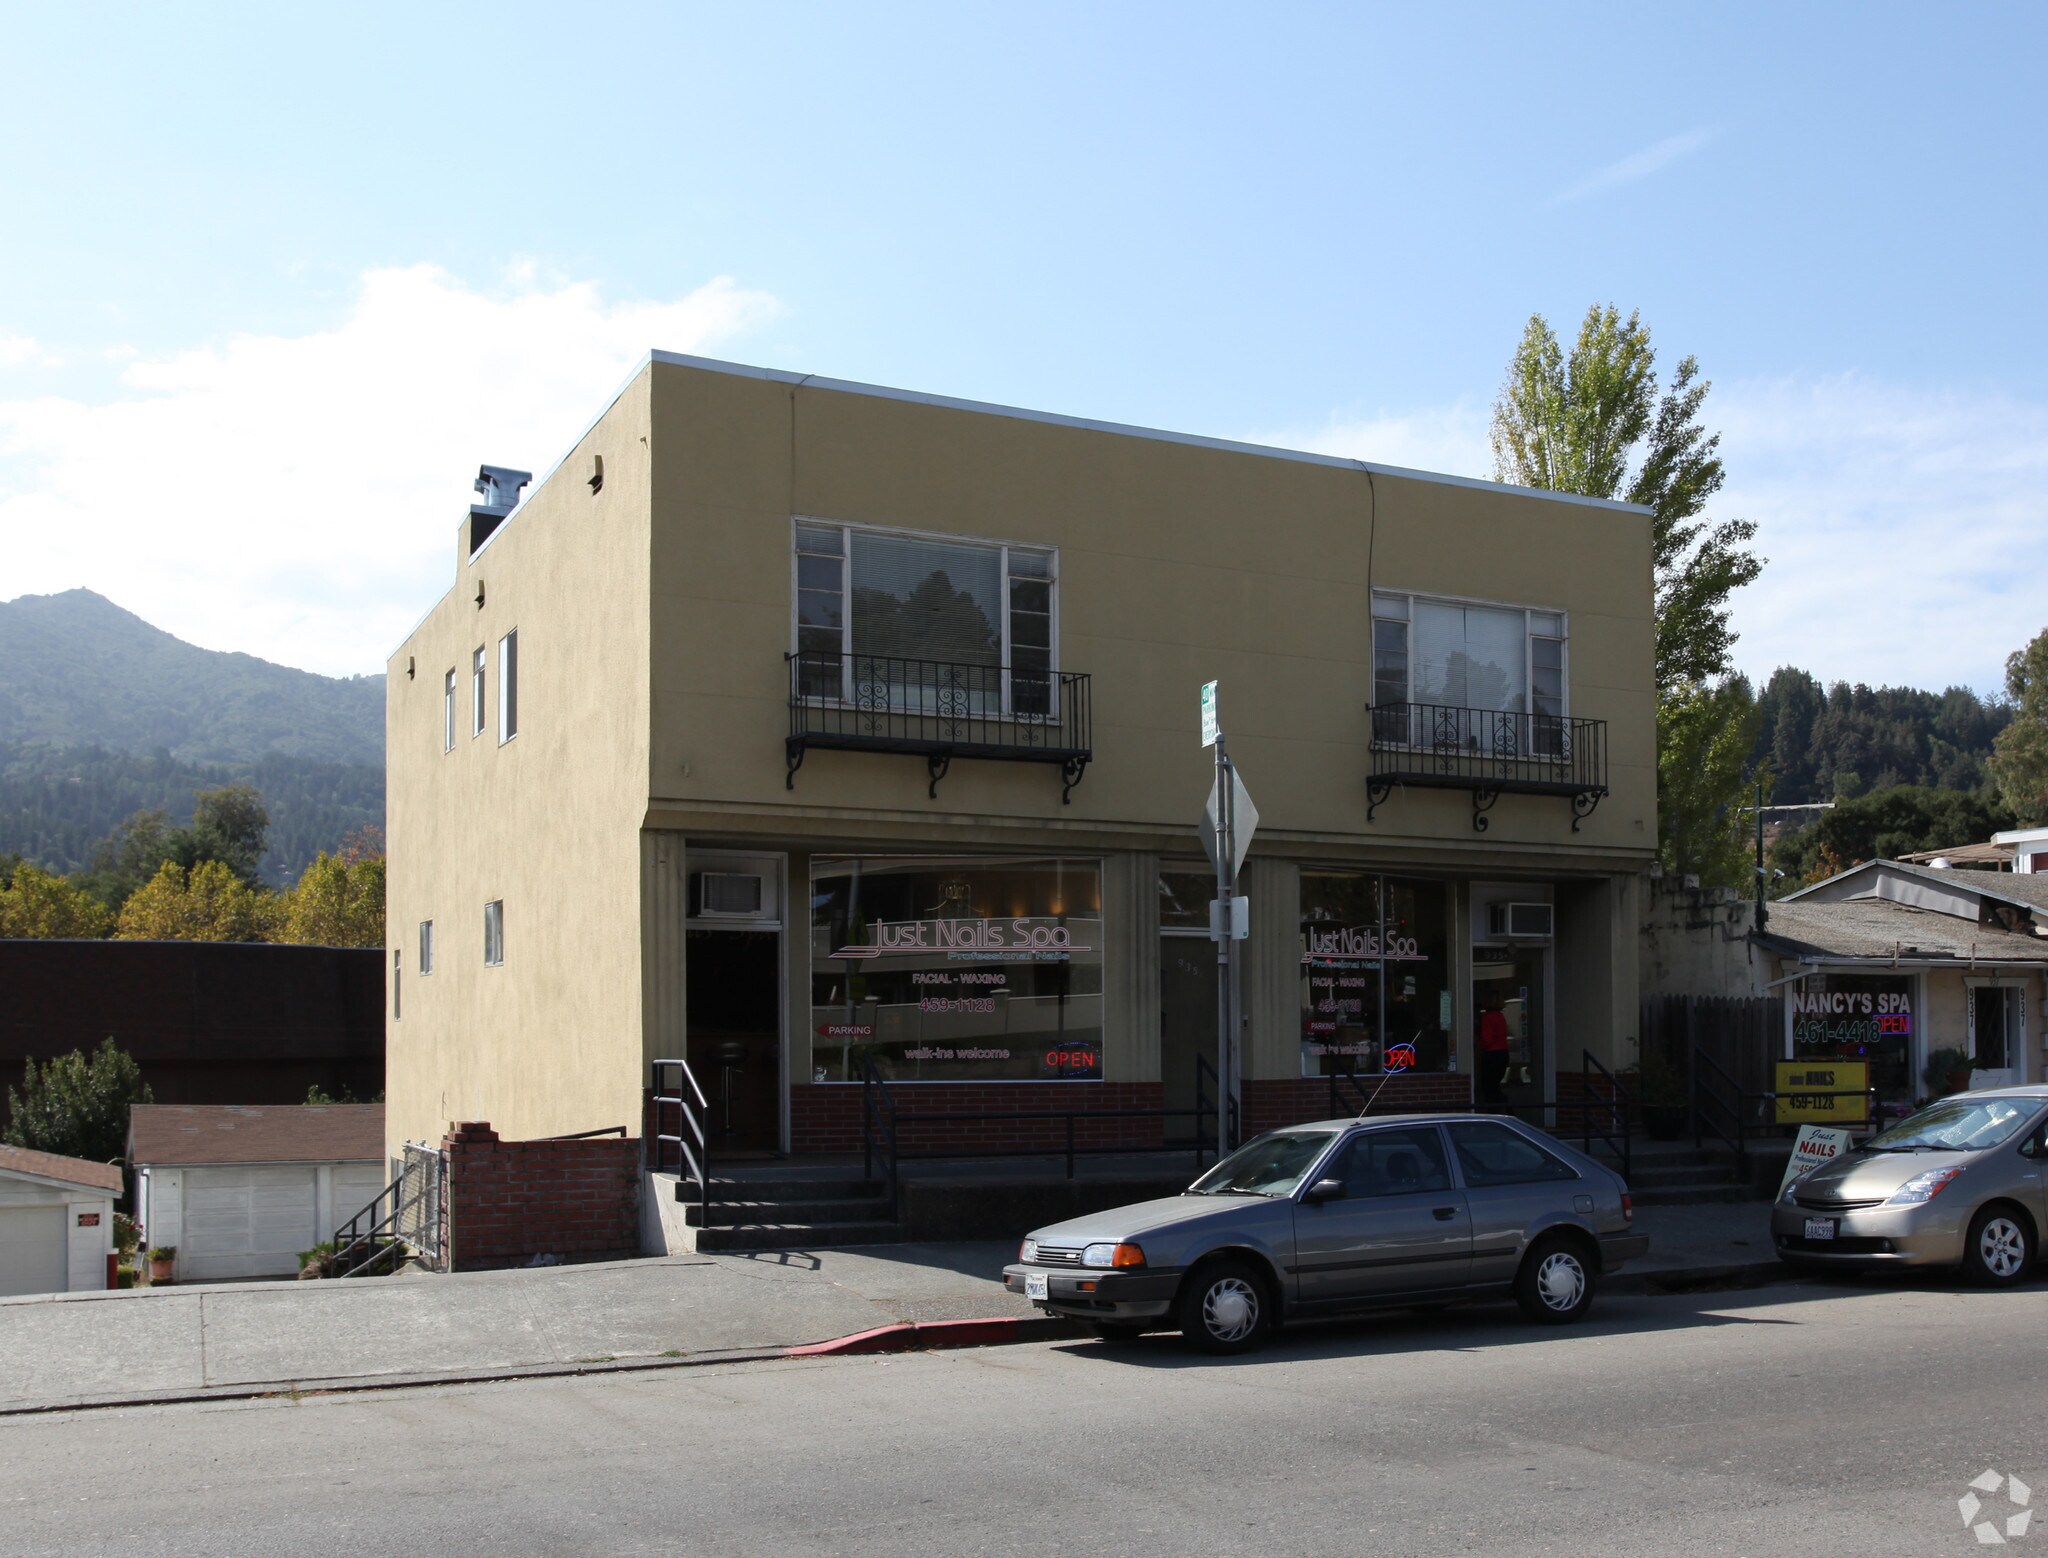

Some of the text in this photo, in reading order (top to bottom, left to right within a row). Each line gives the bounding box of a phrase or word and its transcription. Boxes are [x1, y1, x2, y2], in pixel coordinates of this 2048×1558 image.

[876, 918, 1071, 952] Just Nails Spa
[1309, 926, 1418, 958] Just Nails Spa
[947, 951, 1071, 961] Professional Nails
[912, 972, 953, 985] FACIAL
[960, 972, 1006, 985] WAXING
[917, 997, 996, 1013] 459-1128
[1792, 992, 1911, 1014] NANCY'S SPA
[828, 1025, 871, 1035] PARKING
[1310, 1022, 1336, 1031] PARKING
[1794, 1020, 1882, 1043] 461-4418
[1875, 1015, 1909, 1033] OPEN
[904, 1046, 1010, 1059] walk-ins welcome
[1046, 1051, 1094, 1068] OPEN
[1384, 1049, 1416, 1067] OPEN
[1789, 1095, 1835, 1110] 459-1128
[1809, 1129, 1835, 1140] Just
[1799, 1141, 1836, 1157] NAILS
